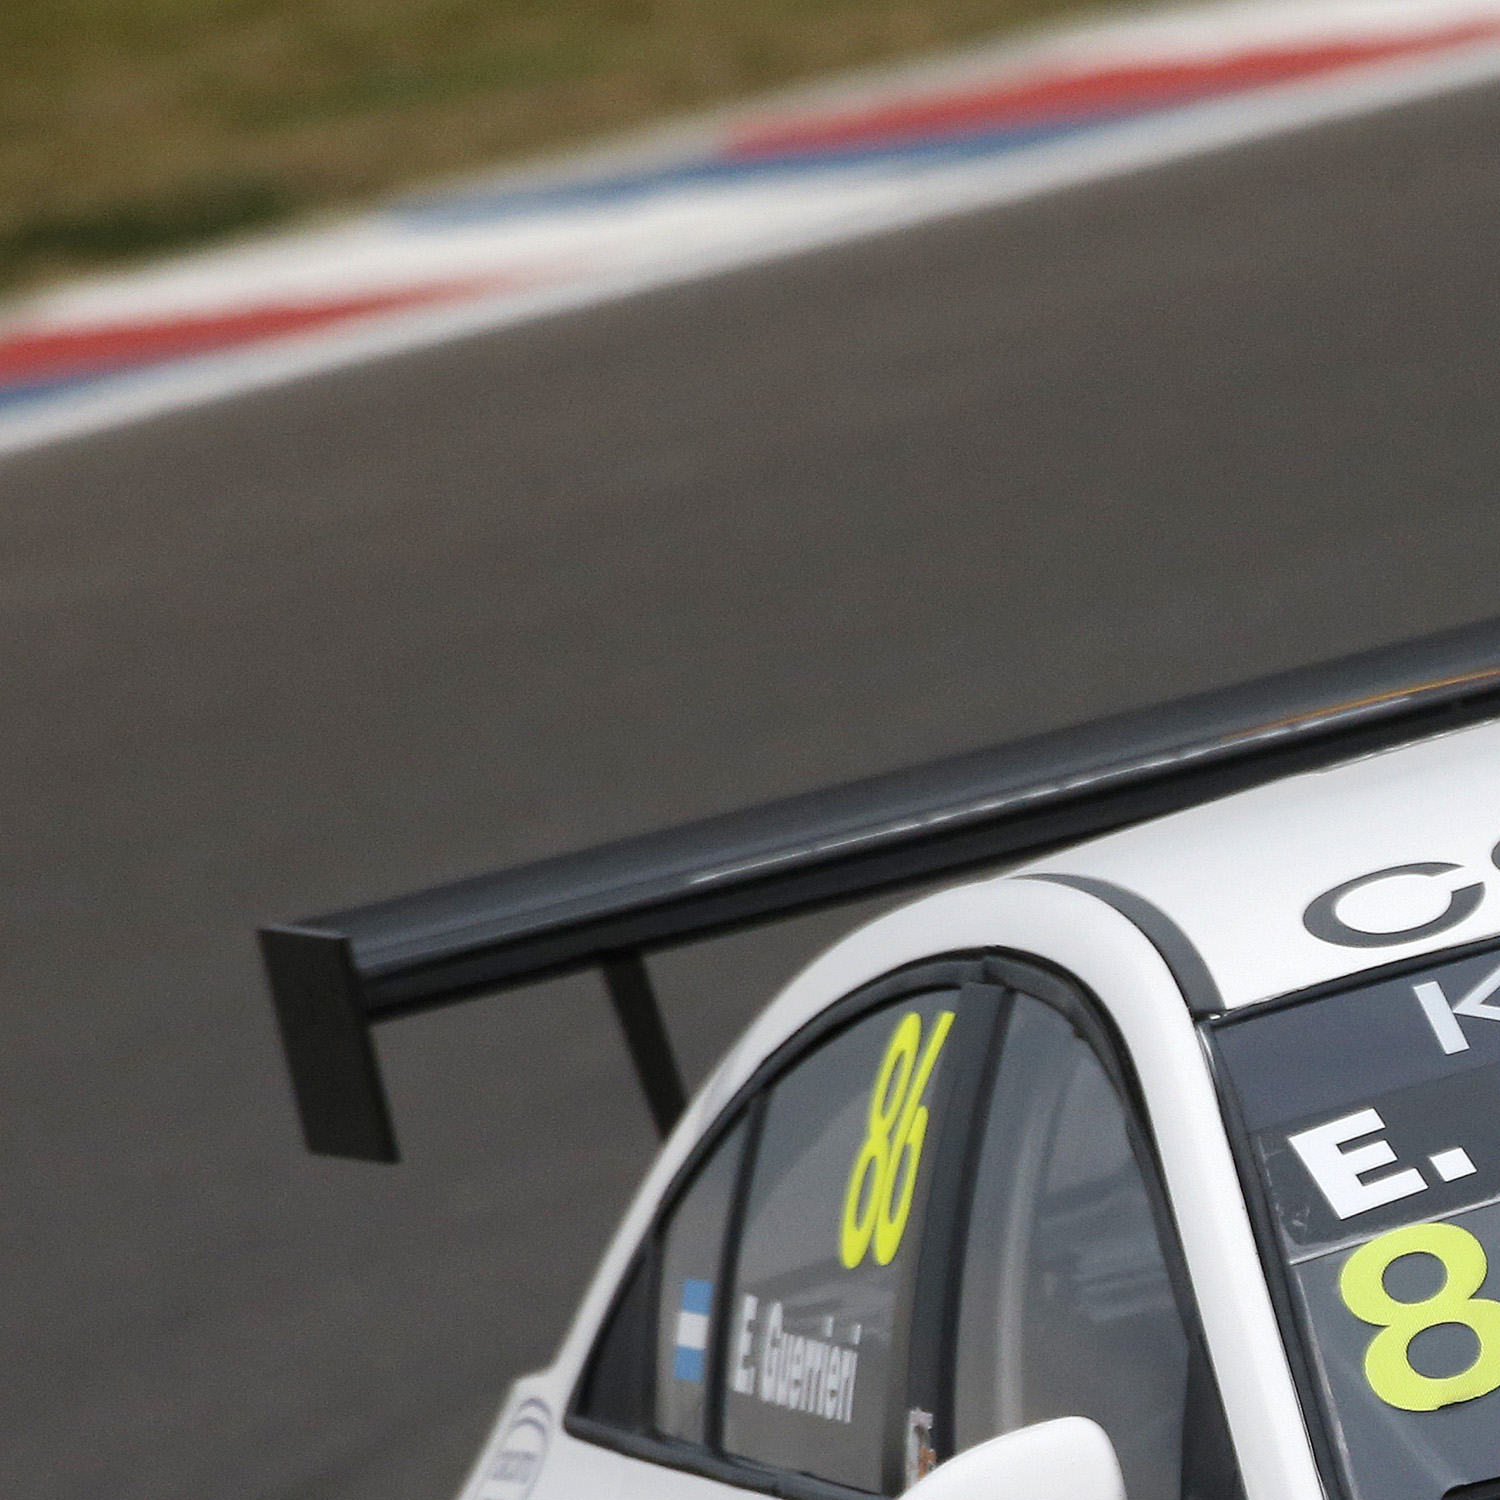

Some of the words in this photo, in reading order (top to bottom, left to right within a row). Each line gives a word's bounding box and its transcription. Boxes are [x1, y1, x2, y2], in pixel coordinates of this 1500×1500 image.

[839, 1010, 957, 1270] 86
[1286, 1108, 1473, 1220] E.
[761, 1300, 862, 1424] Guerrieri
